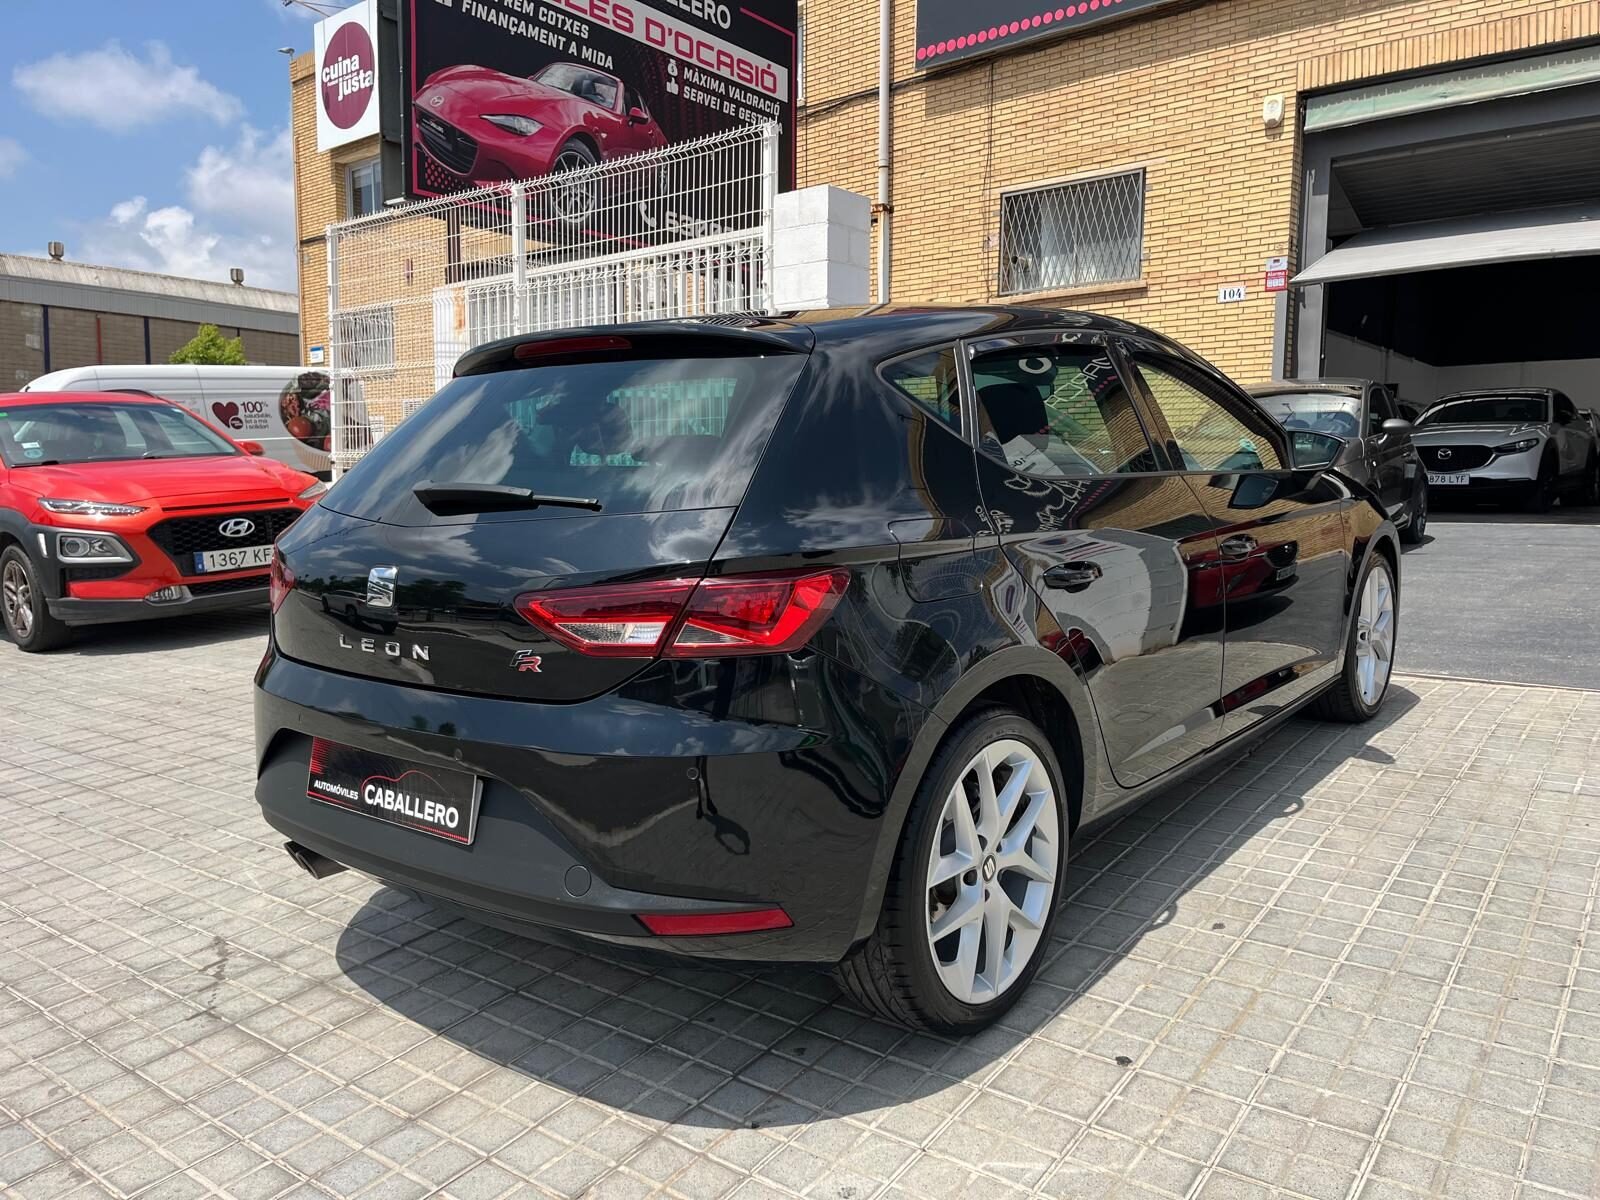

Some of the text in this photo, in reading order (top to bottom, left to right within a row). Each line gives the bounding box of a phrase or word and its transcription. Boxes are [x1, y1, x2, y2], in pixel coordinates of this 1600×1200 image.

[461, 0, 613, 70] FINANÇAMENT A MIDA
[538, 6, 589, 39] COTXES
[322, 54, 359, 83] cuina
[645, 16, 777, 95] D'OCASIÓ
[337, 69, 374, 101] justa
[683, 66, 780, 116] MÀXIMA VALORACIÓ
[683, 86, 720, 111] SERVEI
[722, 100, 737, 117] DE
[1223, 288, 1242, 300] 104
[240, 401, 269, 413] 100%
[1449, 475, 1466, 484] LYF
[209, 551, 247, 568] 1367
[339, 633, 430, 661] LEON
[509, 649, 543, 673] FR
[313, 779, 459, 829] AUTOMÓVILES CABALLERO
